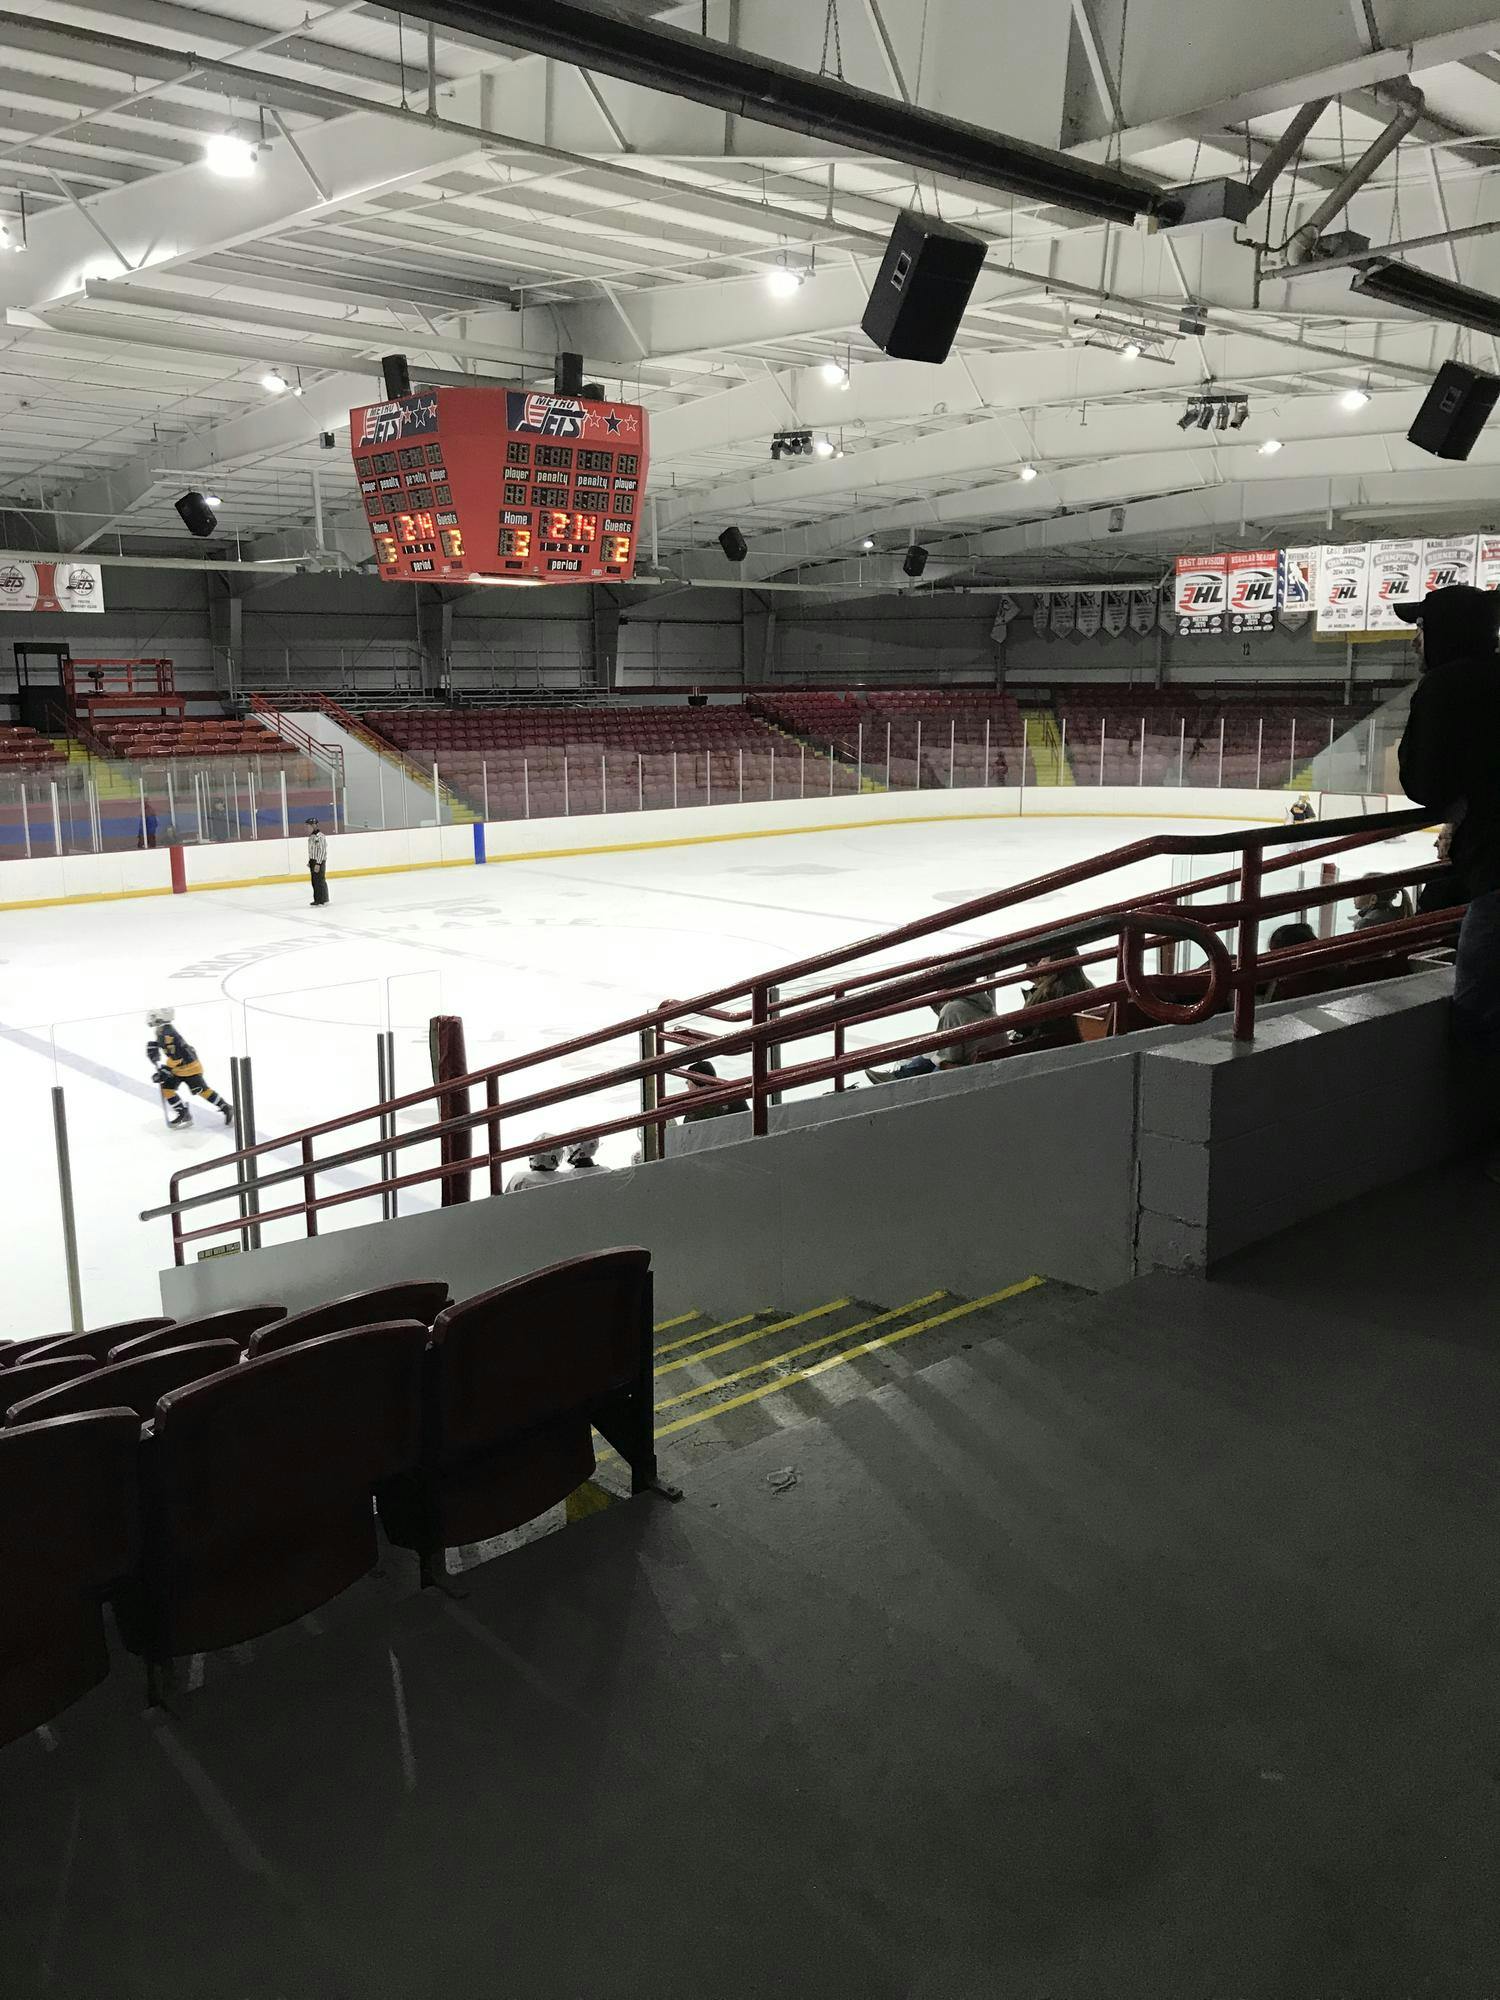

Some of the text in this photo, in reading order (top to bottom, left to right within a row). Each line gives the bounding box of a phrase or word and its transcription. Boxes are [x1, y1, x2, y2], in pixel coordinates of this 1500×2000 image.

[535, 396, 576, 409] METRO
[369, 403, 396, 417] METRO
[359, 410, 403, 447] JETS
[515, 406, 589, 439] JETS
[504, 467, 637, 491] player penalty penalty player
[435, 512, 458, 526] Guests
[504, 511, 528, 525] Home
[372, 521, 389, 533] Home
[604, 519, 632, 533] Guests
[515, 530, 531, 557] 3
[567, 543, 573, 552] 3
[579, 545, 585, 553] 4
[615, 537, 630, 563] 2
[1342, 546, 1366, 554] DIVISION
[412, 559, 433, 572] period
[551, 559, 578, 571] period
[1178, 556, 1226, 567] EAST DIVISION
[1425, 569, 1458, 587] 3HL
[1179, 585, 1223, 604] 3HL
[1231, 582, 1274, 602] 3HL
[1328, 586, 1358, 599] 3HL
[1379, 580, 1409, 595] 3HL
[168, 931, 346, 980] PRIORITY
